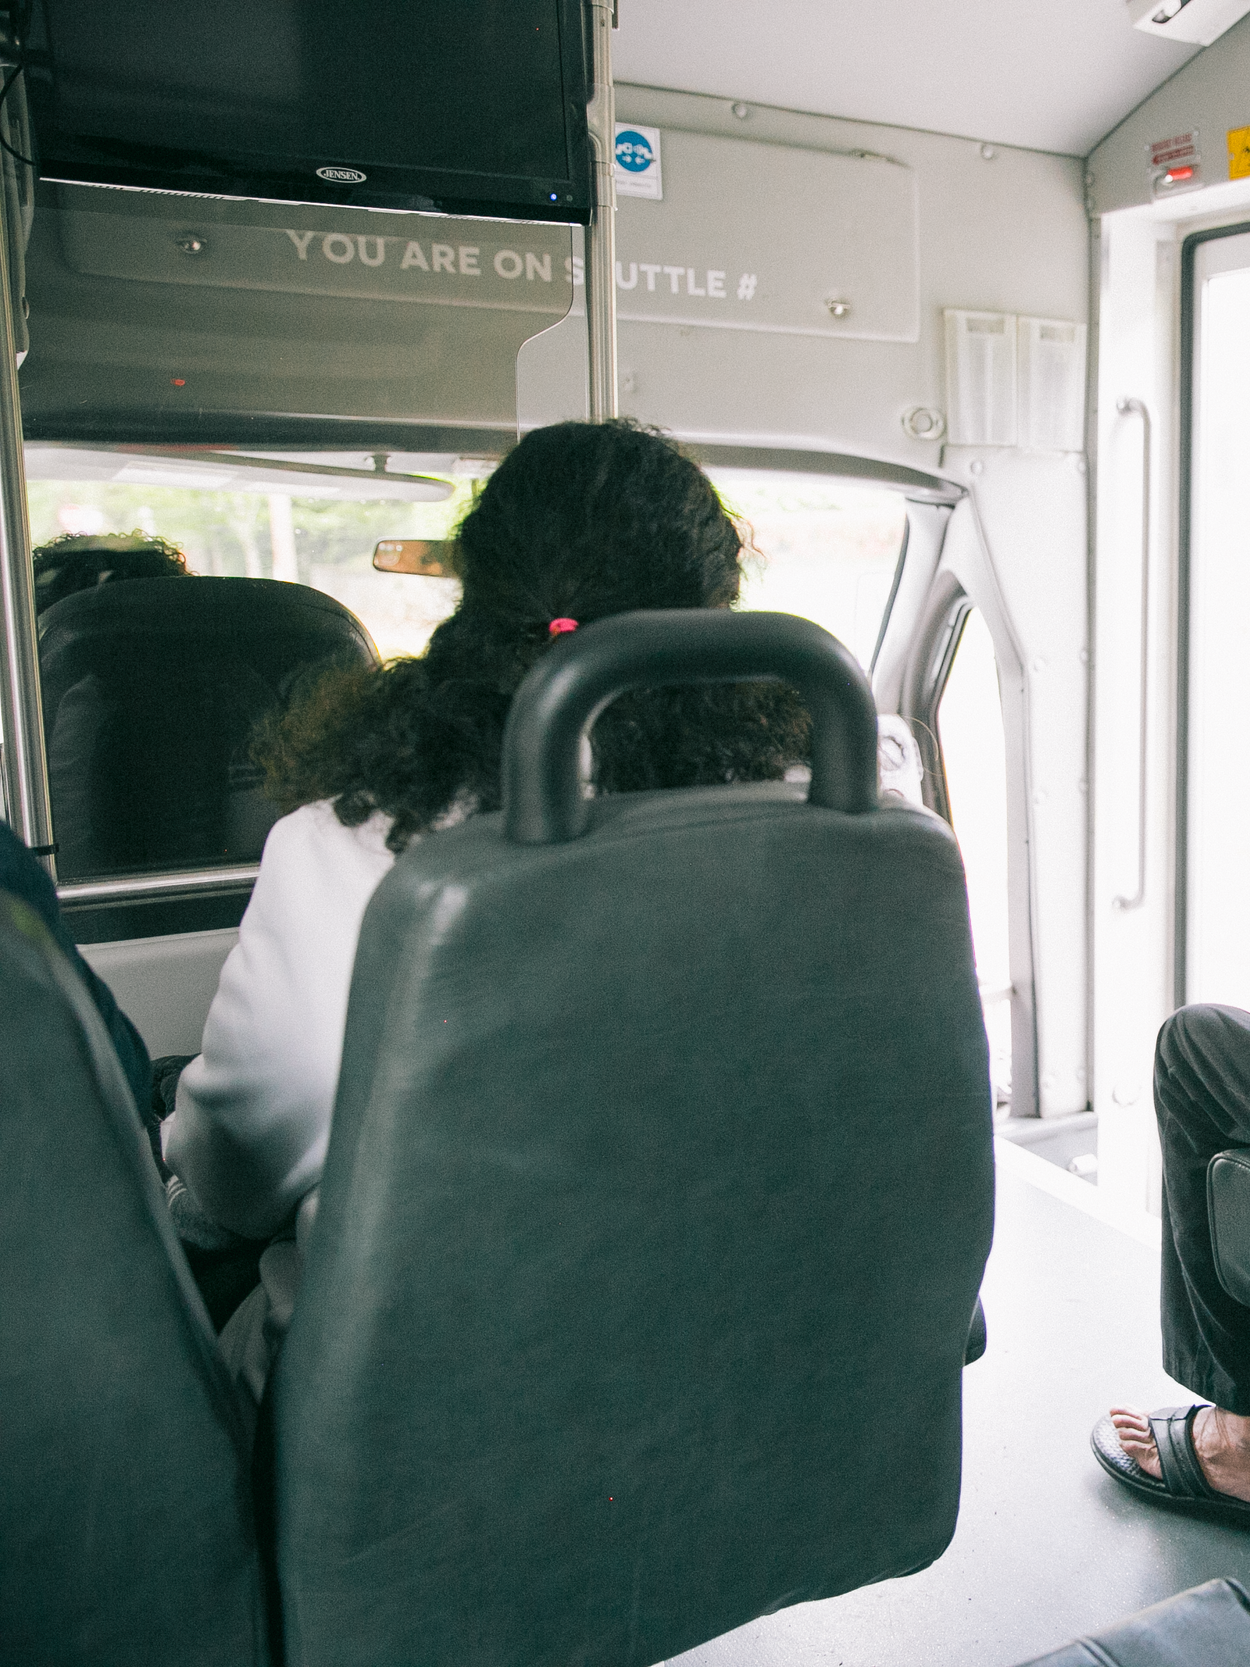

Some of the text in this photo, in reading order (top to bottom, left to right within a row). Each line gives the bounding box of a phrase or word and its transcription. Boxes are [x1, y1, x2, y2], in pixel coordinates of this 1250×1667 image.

[323, 169, 360, 181] JENSEN
[285, 229, 758, 300] YOU ARE ON SUTTLE #
